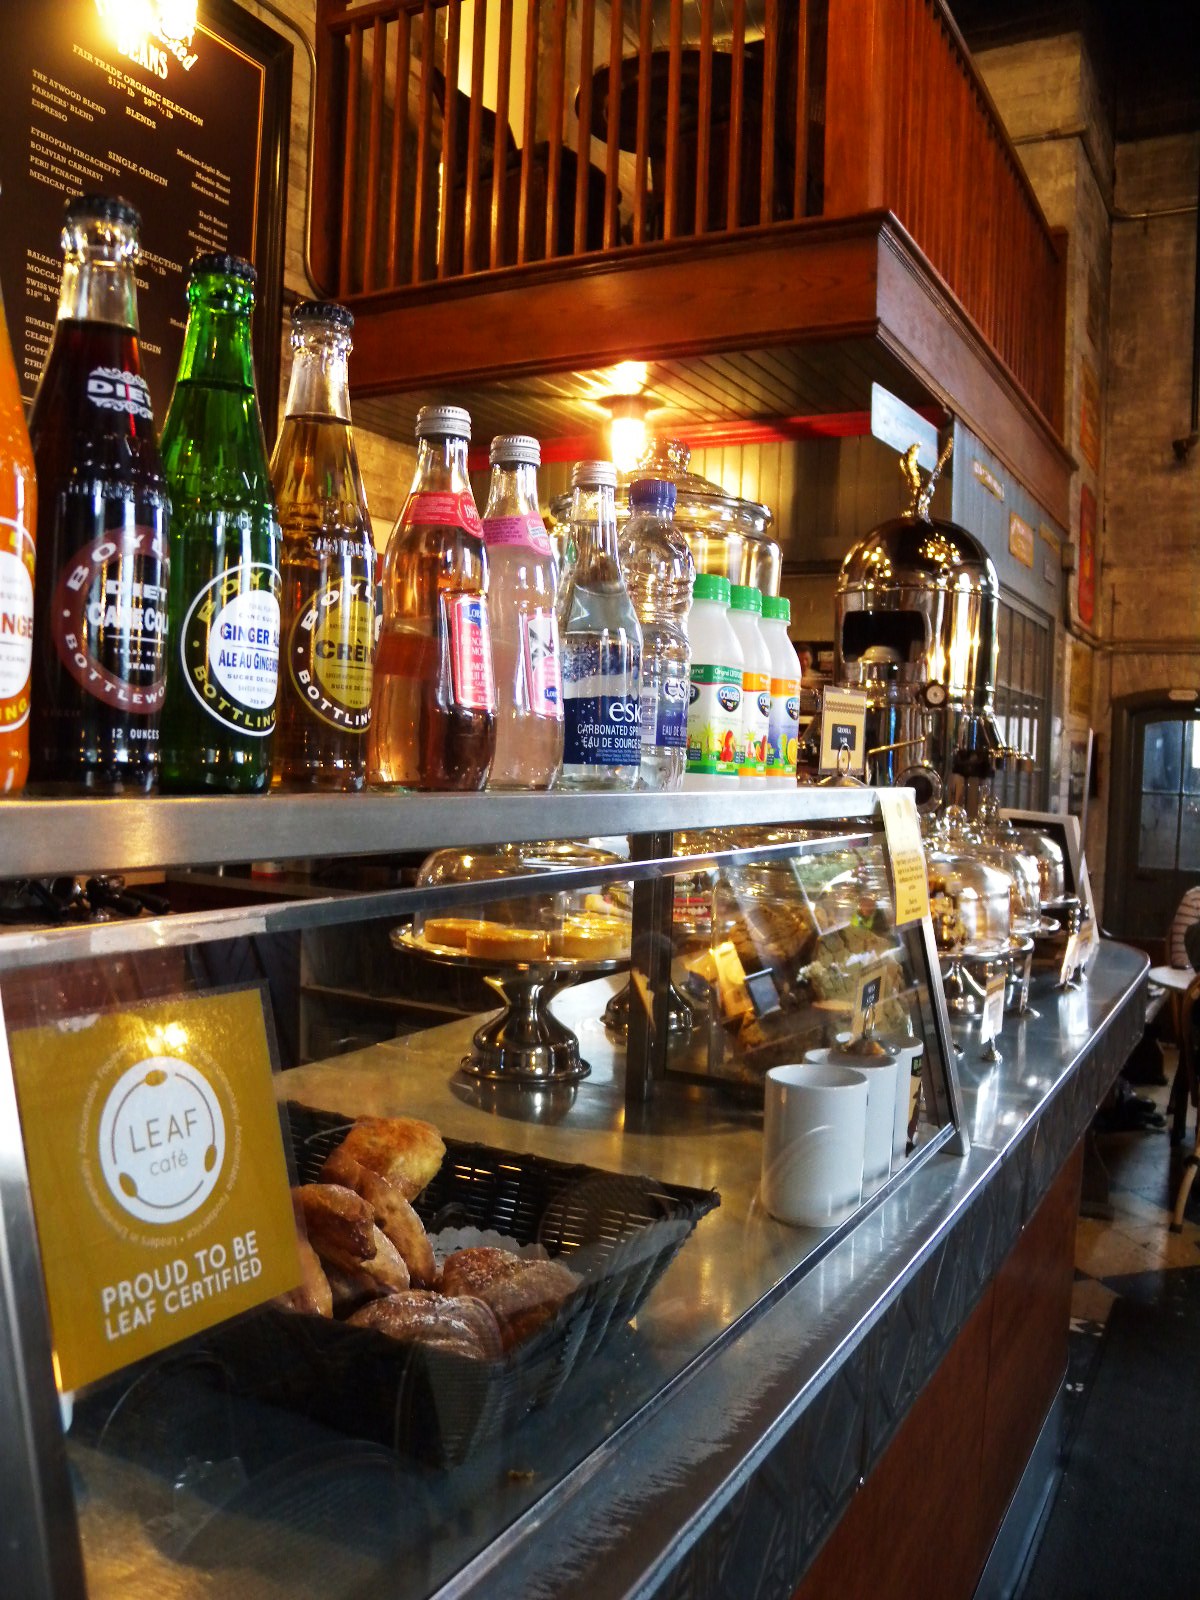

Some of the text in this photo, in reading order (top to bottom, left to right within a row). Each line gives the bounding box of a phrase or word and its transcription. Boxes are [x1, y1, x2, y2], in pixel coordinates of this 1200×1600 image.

[32, 69, 107, 115] THE ATWOOD BLEND
[73, 44, 204, 127] FAIR TRADE ORGANIC SELECTION
[31, 97, 68, 122] ESPRESSO
[70, 104, 94, 122] BLEND
[125, 106, 157, 129] BLENDS
[31, 126, 72, 152] ETHIOPIAN
[30, 140, 104, 182] BOLIVIAN CARANAVI
[30, 155, 83, 185] PERU PENACHI
[108, 150, 169, 187] SINGLE ORIGIN
[29, 169, 65, 191] MEXICAN
[26, 249, 62, 269] BALZAC'S
[26, 277, 48, 290] SWISS
[139, 341, 161, 355] RIGIN
[220, 622, 270, 645] GINGER
[219, 649, 238, 668] ALE
[315, 638, 367, 663] CRÈ
[65, 632, 169, 705] BOTTLEWO
[112, 727, 160, 740] 12 OUNCES
[577, 723, 628, 737] CARBONATED
[582, 736, 600, 749] EAU
[602, 737, 613, 749] DE
[129, 1107, 198, 1154] LEAF
[149, 1149, 190, 1177] café
[102, 1230, 260, 1315] PROUD TO BE
[105, 1256, 263, 1342] LEAF CERTIFIED
